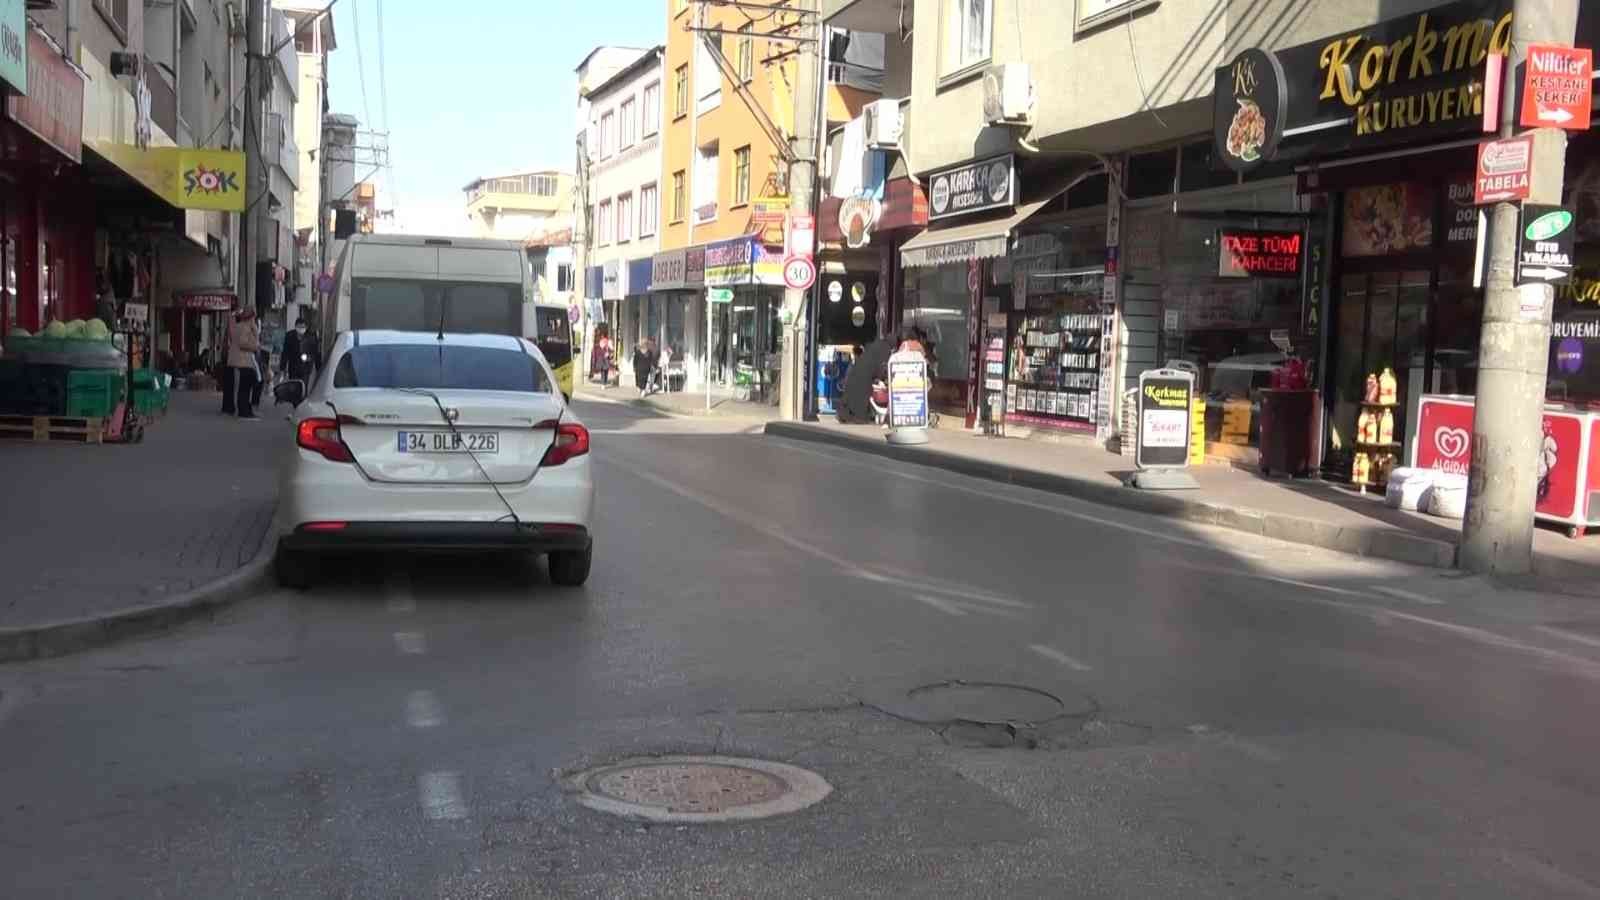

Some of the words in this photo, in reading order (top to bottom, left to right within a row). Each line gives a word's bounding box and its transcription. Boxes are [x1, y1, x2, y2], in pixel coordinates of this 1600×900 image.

[1318, 11, 1512, 106] Korkma
[1530, 52, 1586, 76] Nilüfer
[1531, 76, 1586, 90] KESTANE
[1355, 80, 1484, 136] KURUYEM
[949, 165, 989, 194] KARACA
[1479, 173, 1529, 192] TABELA
[1224, 236, 1258, 253] TAZE
[1534, 242, 1559, 253] OTO
[1524, 252, 1570, 266] YIKAMA
[789, 266, 808, 282] 30
[1551, 320, 1600, 338] RUYEMİ
[408, 433, 426, 449] 34
[468, 433, 496, 450] 226
